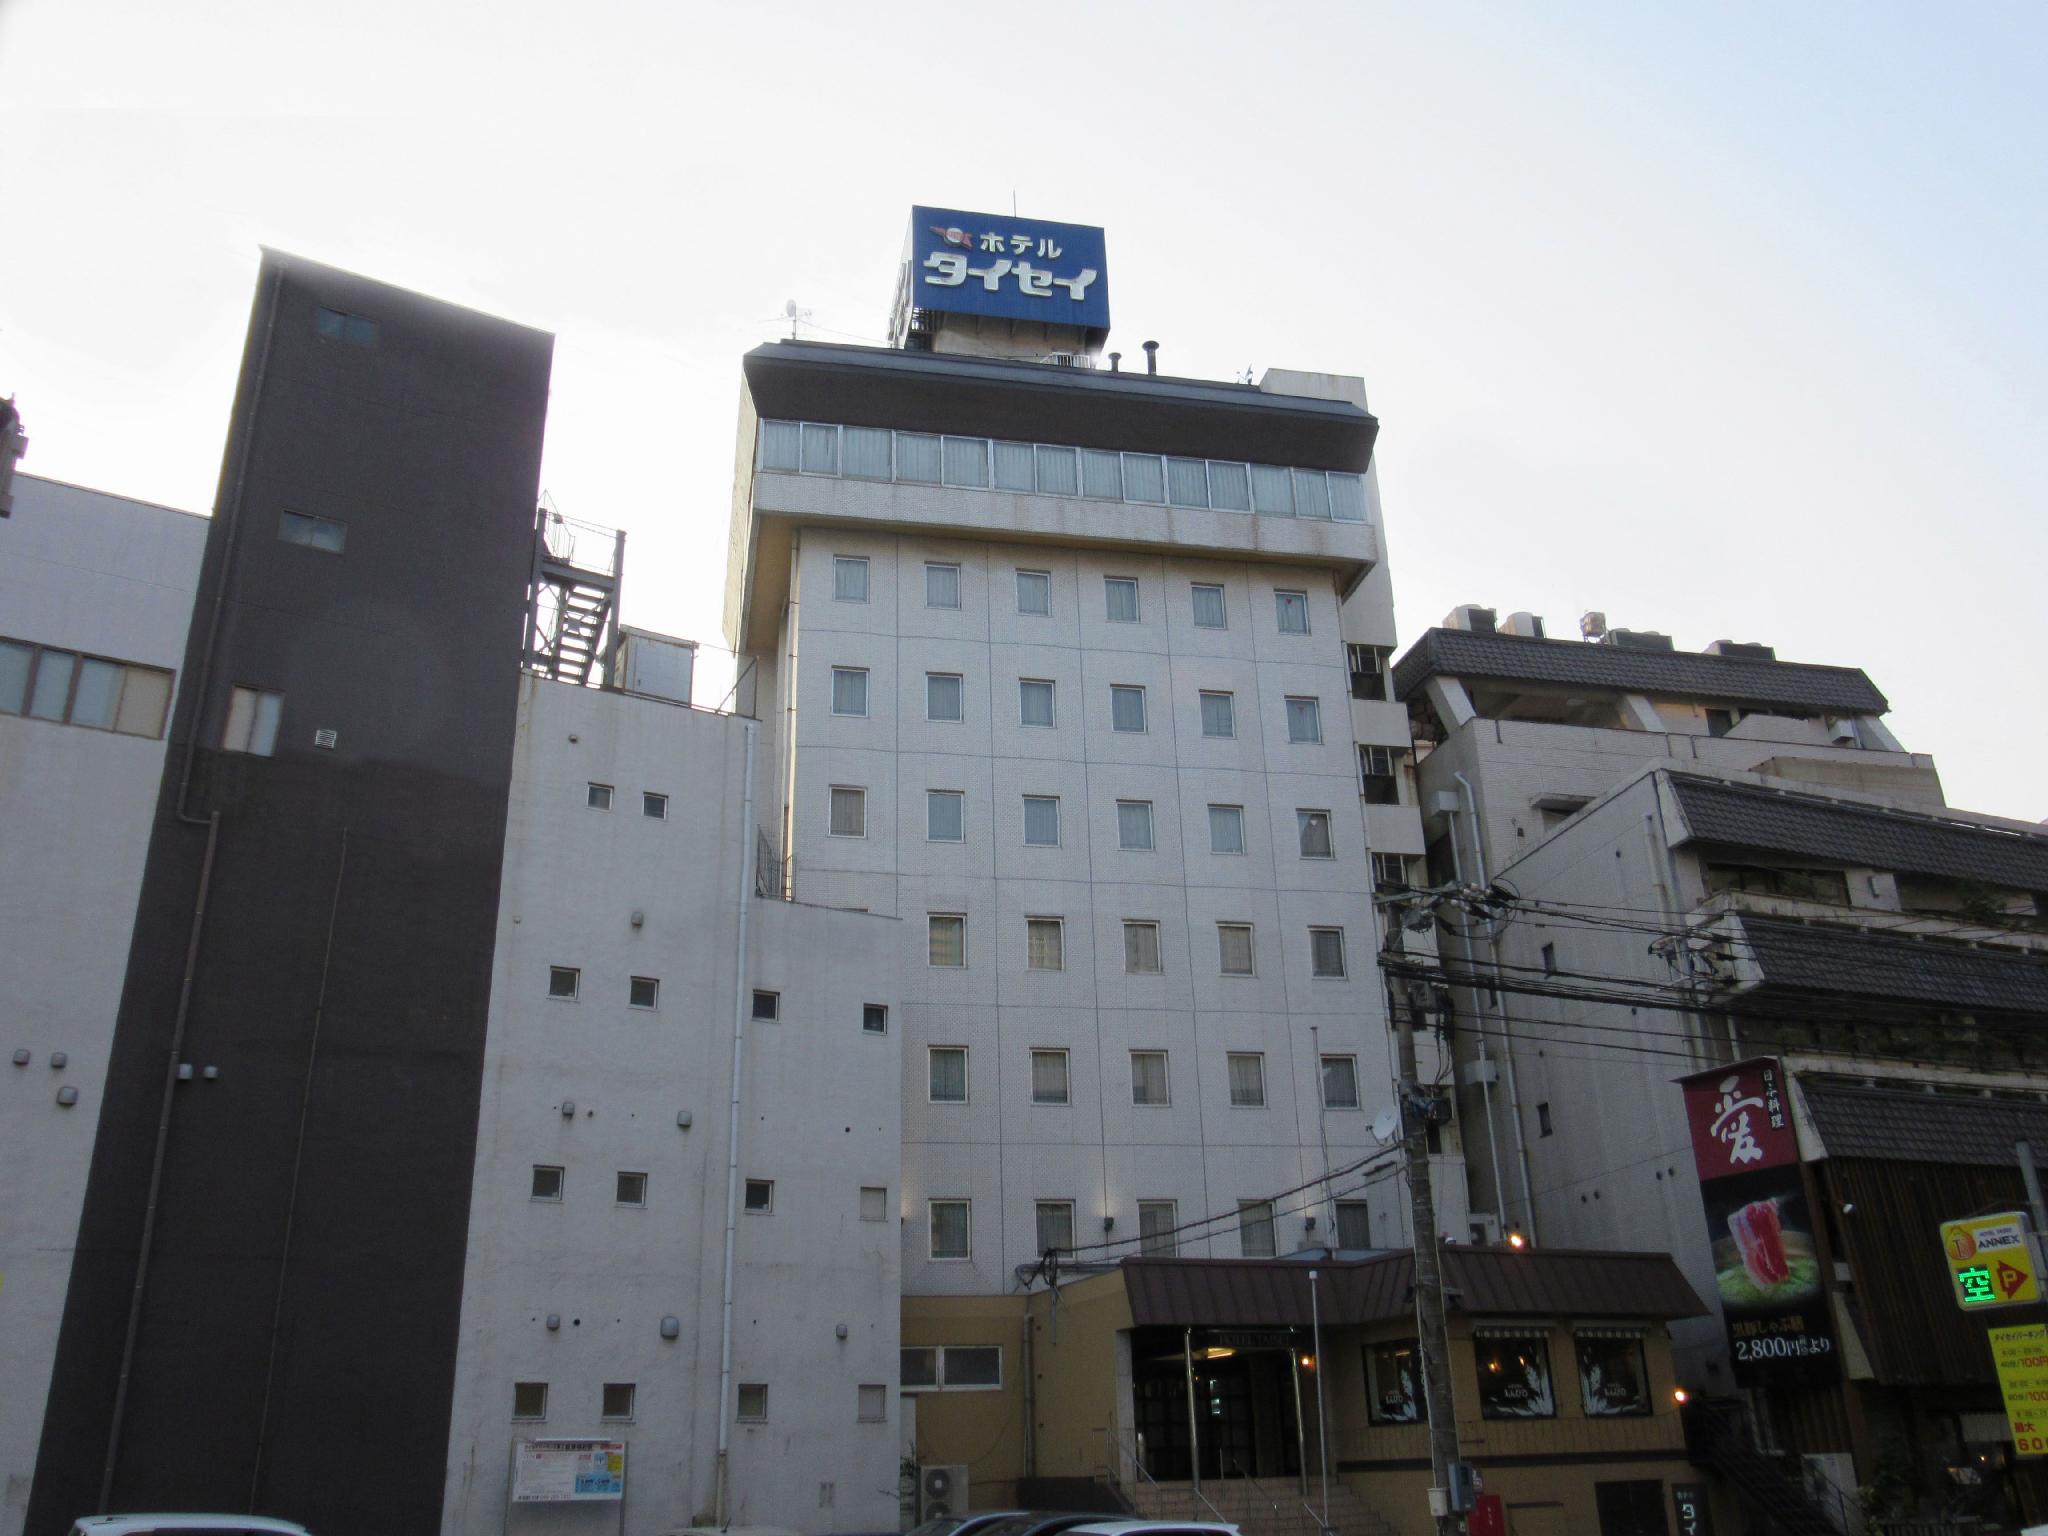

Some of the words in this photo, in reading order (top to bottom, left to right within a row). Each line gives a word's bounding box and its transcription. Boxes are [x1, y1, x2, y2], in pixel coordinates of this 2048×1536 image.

[980, 232, 1062, 259] ホテル
[922, 252, 1097, 301] タイセイ
[1710, 1075, 1765, 1165] 愛
[1978, 1234, 2021, 1249] ANNEX
[1958, 1267, 1996, 1302] 空
